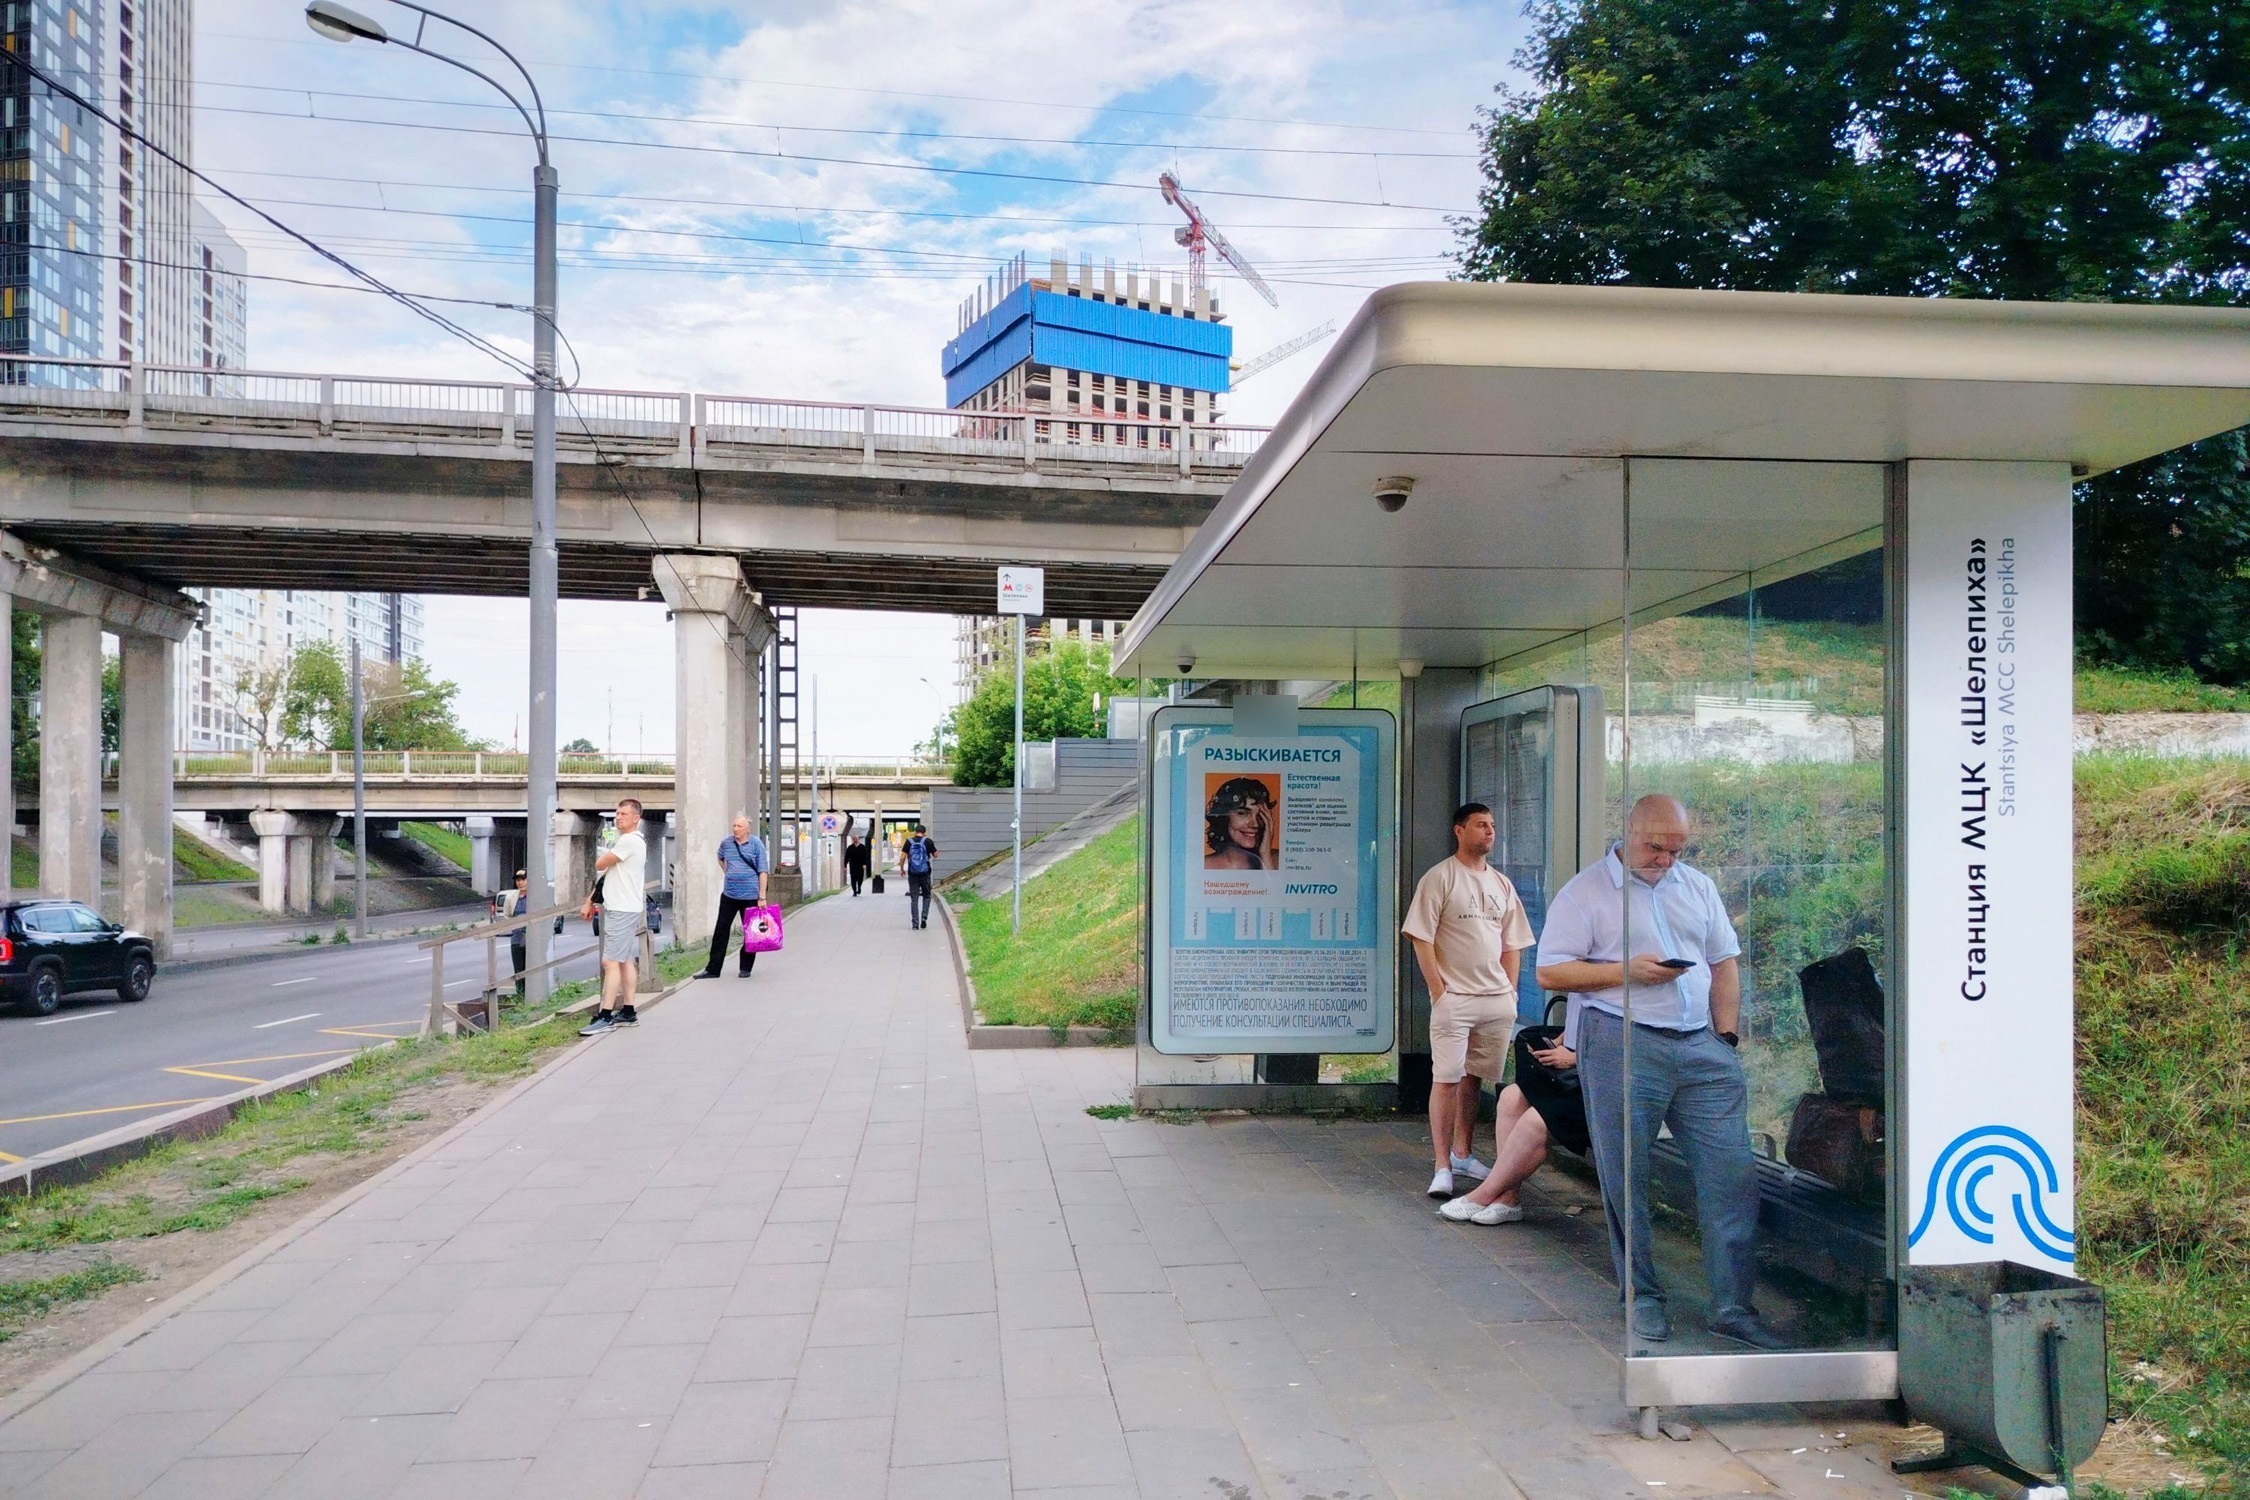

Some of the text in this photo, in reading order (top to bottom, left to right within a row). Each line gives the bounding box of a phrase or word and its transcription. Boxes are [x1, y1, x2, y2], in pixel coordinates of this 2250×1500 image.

[1997, 537, 2019, 816] Stantsiya MCC Shelepikha
[1204, 747, 1341, 763] РАЗЫСКИВАЕТСЯ
[1961, 538, 1990, 1001] Станция МЦК «Шелепиха»
[1287, 774, 1341, 782] Естественная
[1287, 782, 1321, 790] красота!
[1203, 880, 1250, 889] Нашедшему
[1285, 884, 1338, 894] INVITRO
[1203, 888, 1268, 896] вознаграждение!
[1173, 998, 1367, 1012] ИМЕЮТСЯ ПРОТИВОПОКАЗАНИЯ. НЕОБХОДИМО
[1173, 1014, 1354, 1029] ПОЛУЧЕНИЕ КОНСУЛЬТАЦИИ СПЕЦИАЛИСТА.
